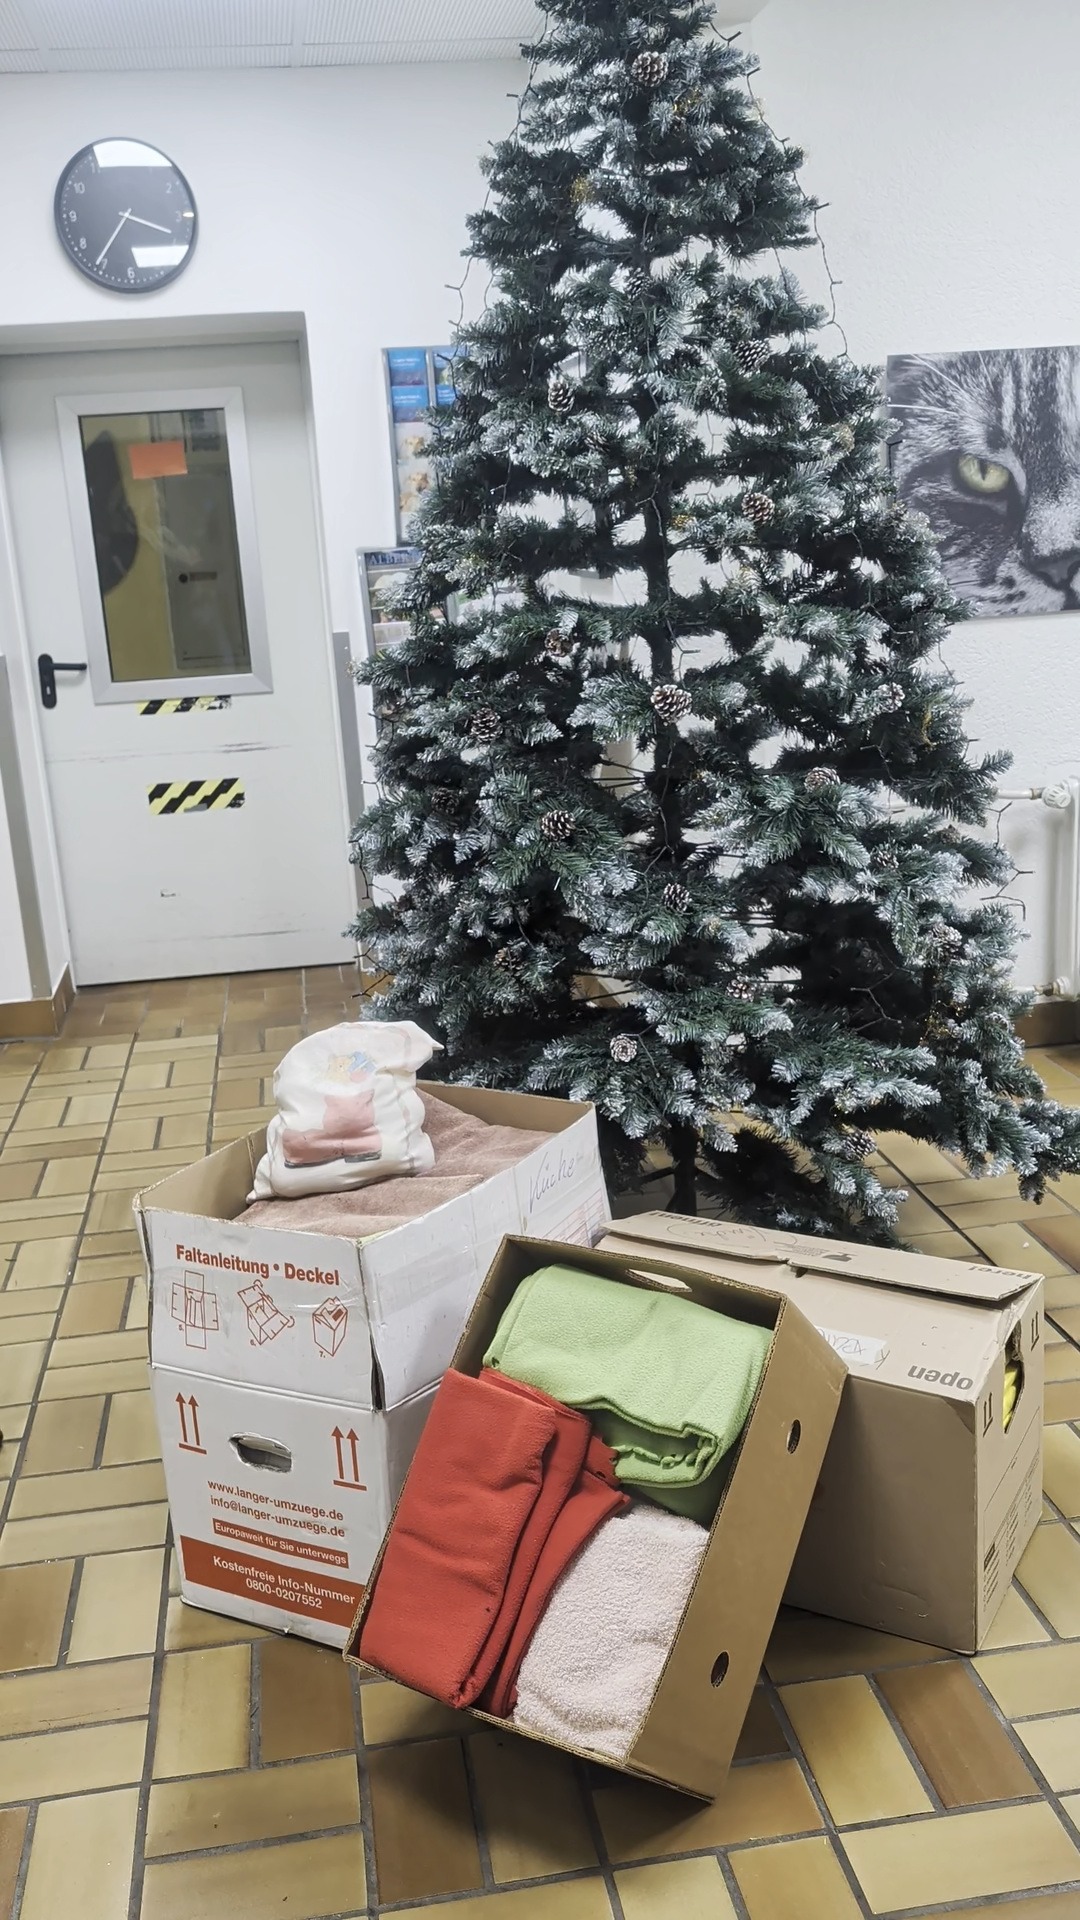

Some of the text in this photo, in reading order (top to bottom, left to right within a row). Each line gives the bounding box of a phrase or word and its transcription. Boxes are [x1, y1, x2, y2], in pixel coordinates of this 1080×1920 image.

[73, 181, 86, 195] 10
[165, 183, 173, 194] 2
[68, 210, 77, 222] 9
[175, 211, 183, 223] 3
[79, 237, 87, 250] 8
[127, 266, 136, 279] 6
[175, 1244, 340, 1286] Faltanleitung Deckel
[907, 1364, 974, 1392] open
[207, 1479, 344, 1522] www.langer-umzuege.de
[210, 1495, 345, 1538] info@langer-umzuege.de
[215, 1522, 347, 1565] Europaweit für Sie unterwegs
[213, 1555, 356, 1605] Kostenfreie Info-Nummer
[245, 1578, 323, 1609] 0800-0207552
